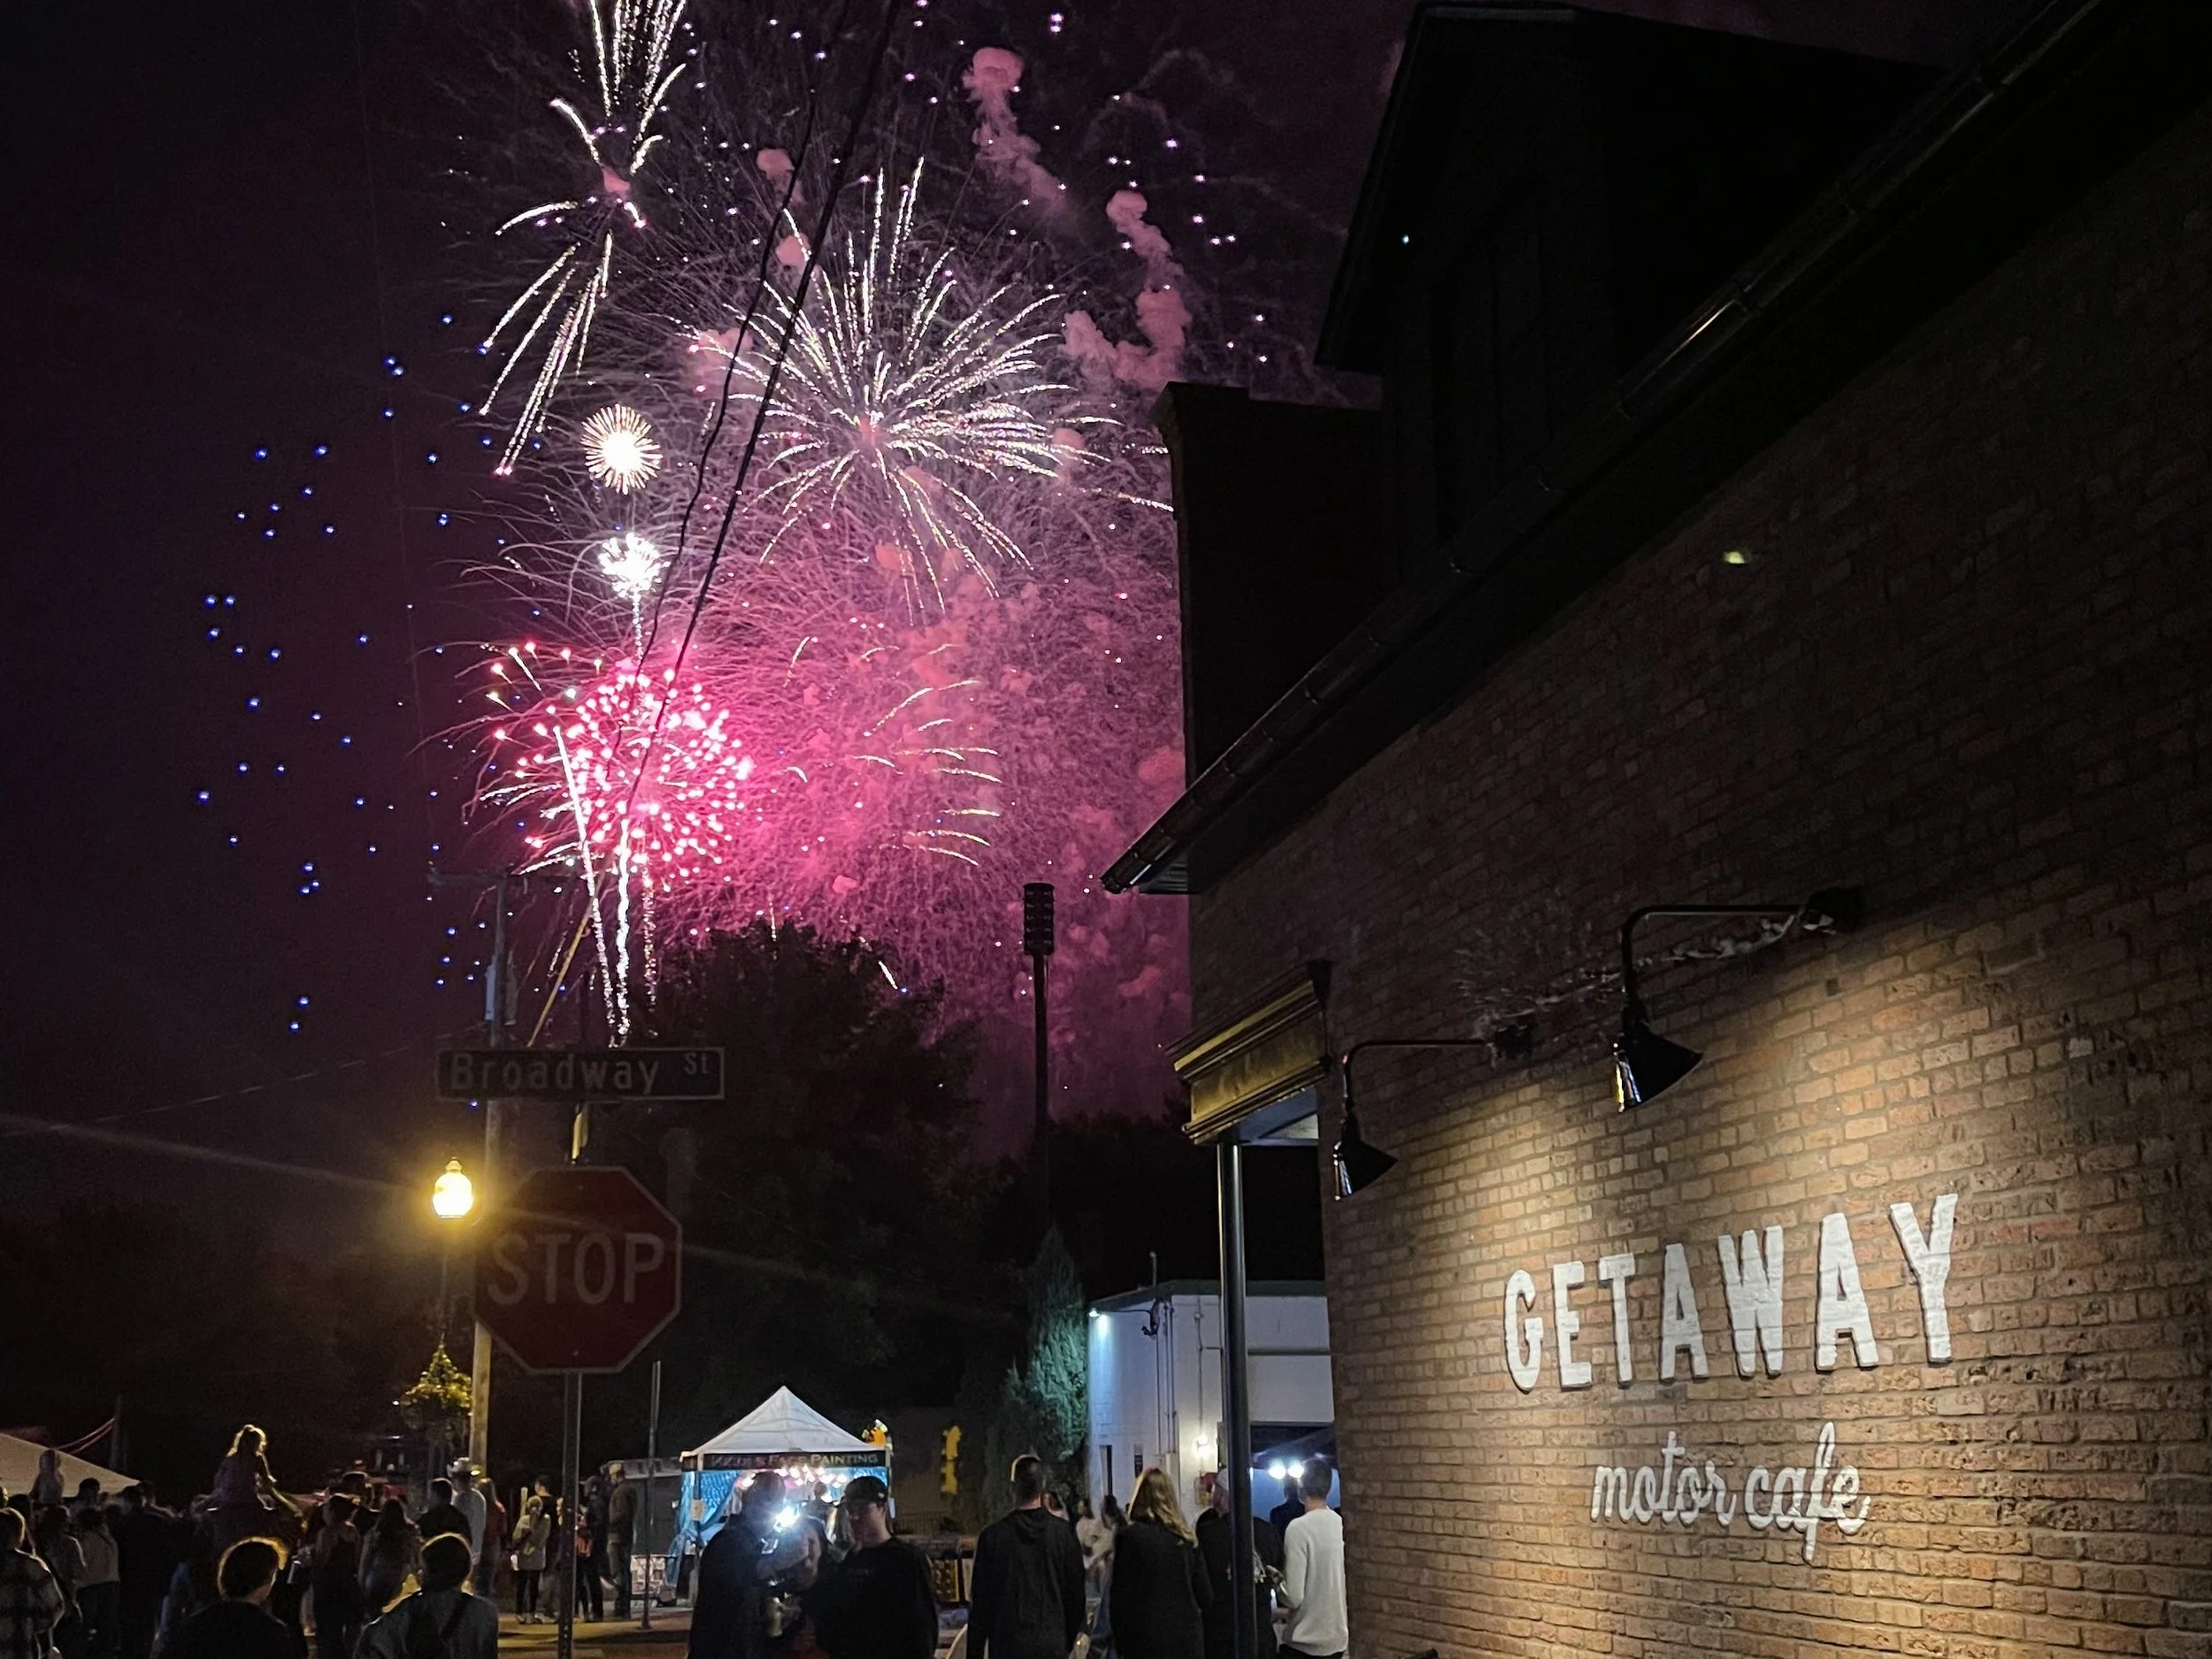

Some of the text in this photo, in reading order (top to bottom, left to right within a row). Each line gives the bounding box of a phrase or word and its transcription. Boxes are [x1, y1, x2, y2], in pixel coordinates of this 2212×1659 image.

[449, 1051, 710, 1095] Broadway St
[488, 1232, 664, 1306] STOP
[1503, 1193, 1959, 1394] GETAWAY
[810, 1453, 879, 1465] PAINTING
[1591, 1421, 1872, 1565] motor cafe
